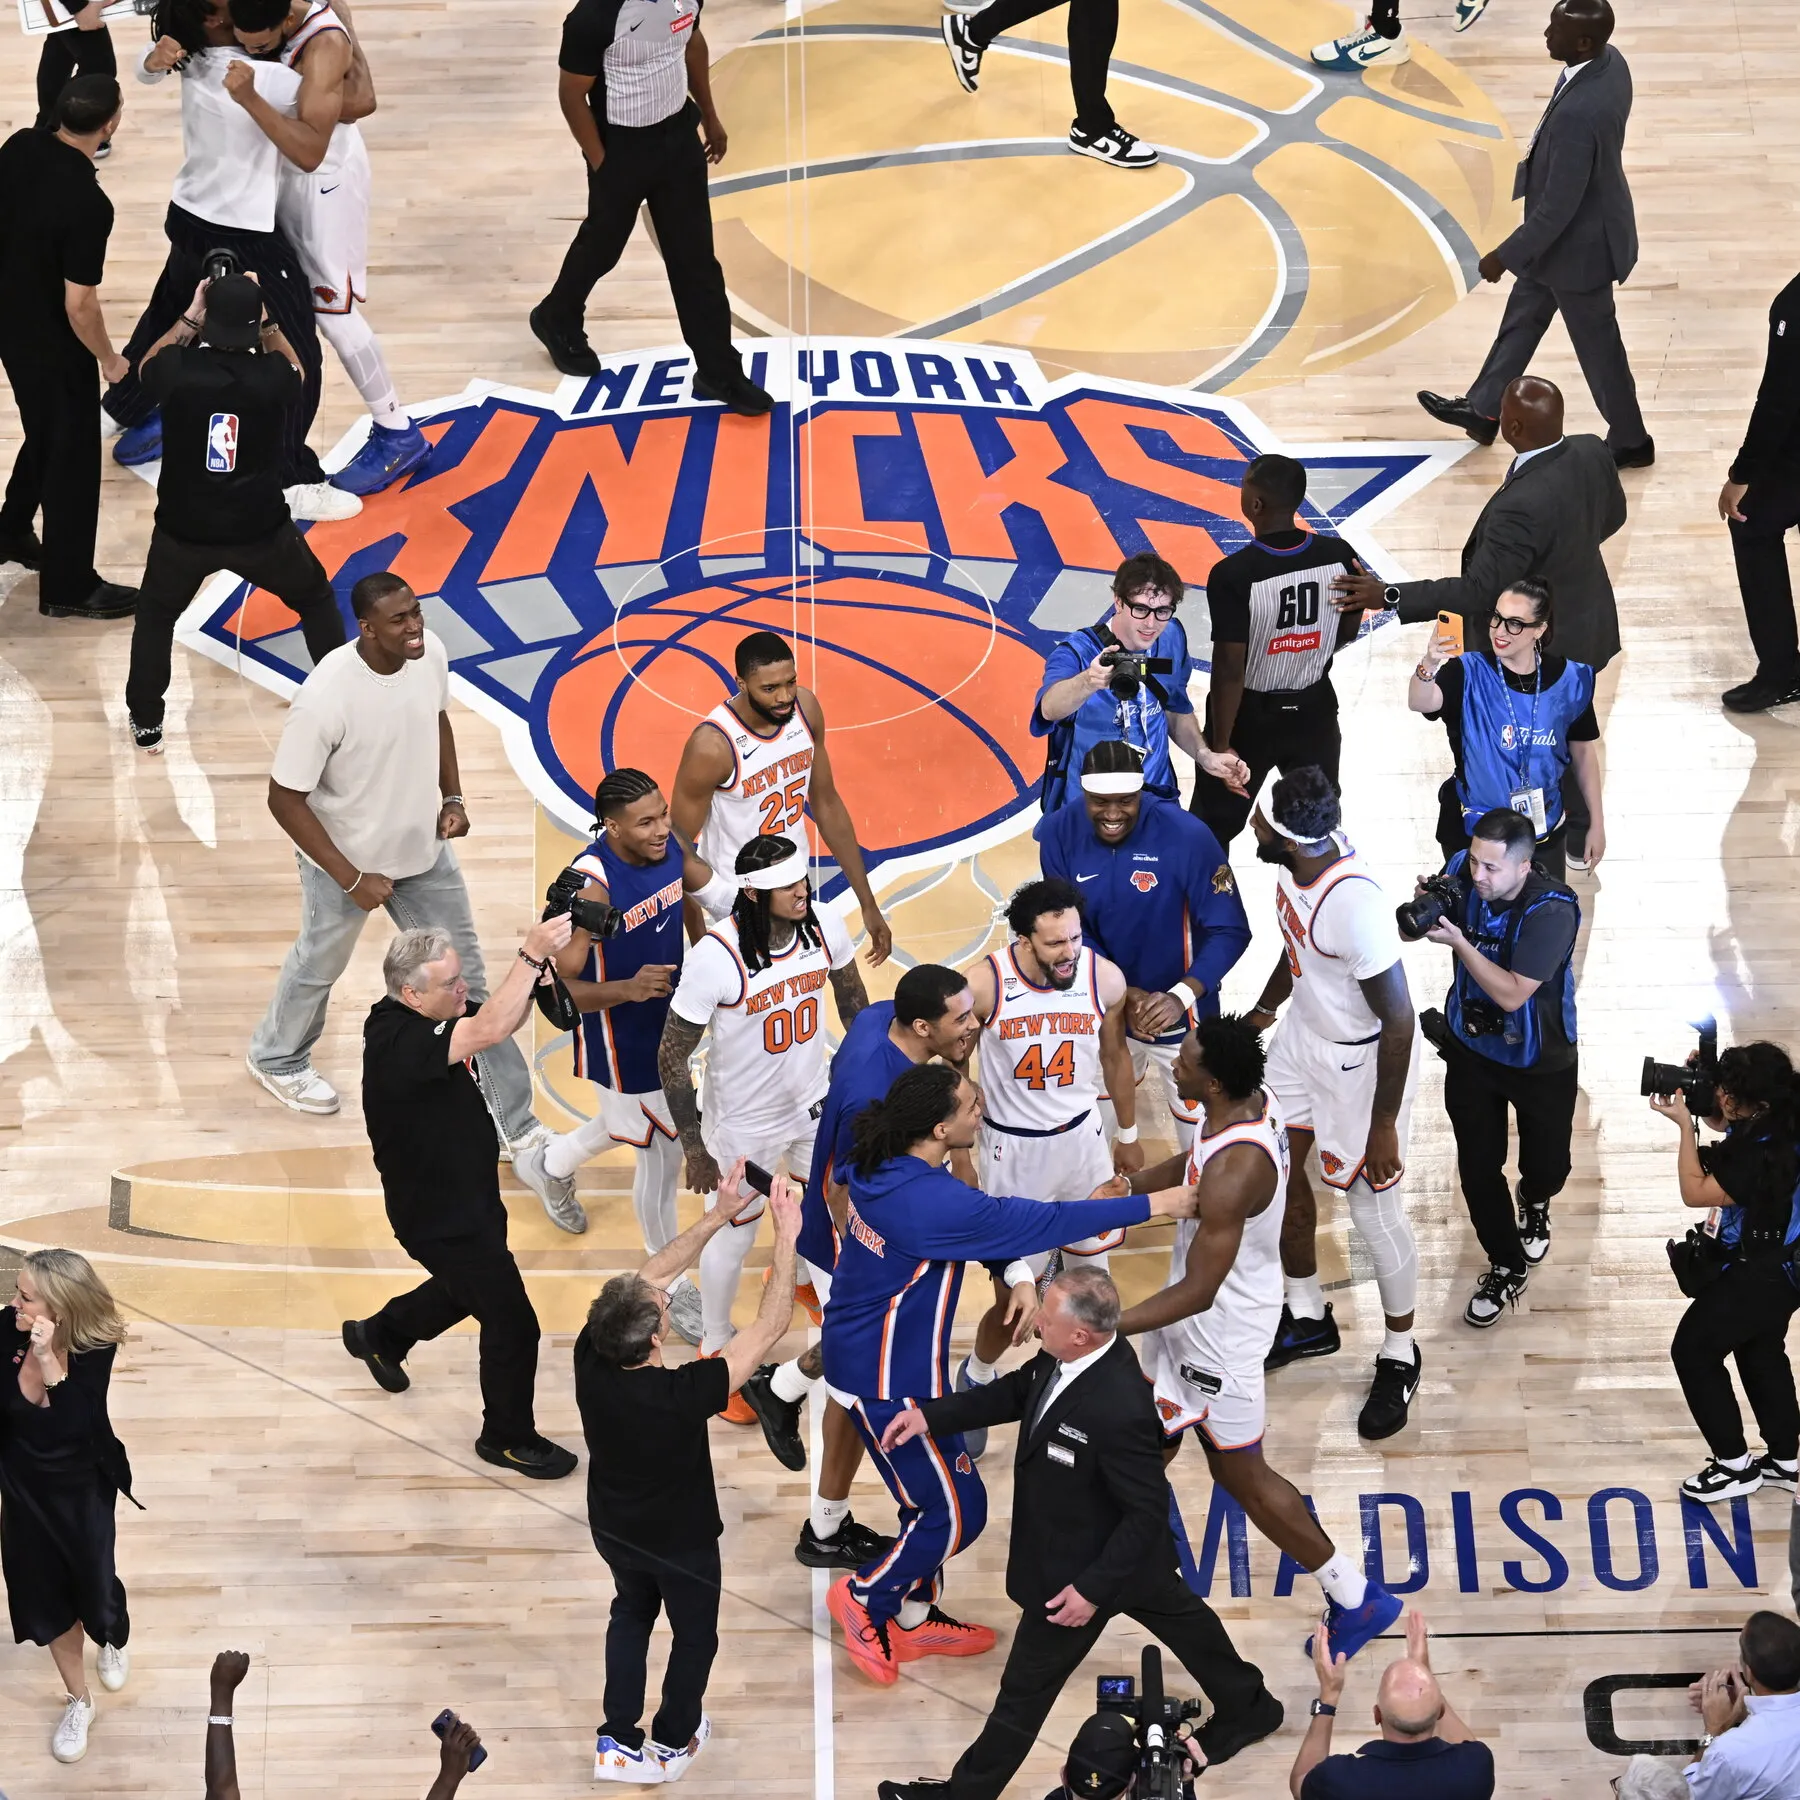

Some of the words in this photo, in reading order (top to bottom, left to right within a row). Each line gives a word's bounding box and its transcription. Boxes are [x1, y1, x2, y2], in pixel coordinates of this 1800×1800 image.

[798, 350, 1033, 406] YORK
[210, 458, 225, 468] NBA
[1276, 581, 1320, 629] 60
[1273, 637, 1315, 650] Emirates
[742, 762, 778, 798] NEW
[778, 747, 813, 779] YORK
[759, 776, 806, 836] 25
[623, 893, 658, 933] NEW
[746, 981, 785, 1016] NEW
[787, 967, 828, 997] YORK
[763, 997, 817, 1055] 00
[999, 1013, 1044, 1040] NEW
[1046, 1012, 1095, 1035] YORK
[1014, 1040, 1075, 1090] 44
